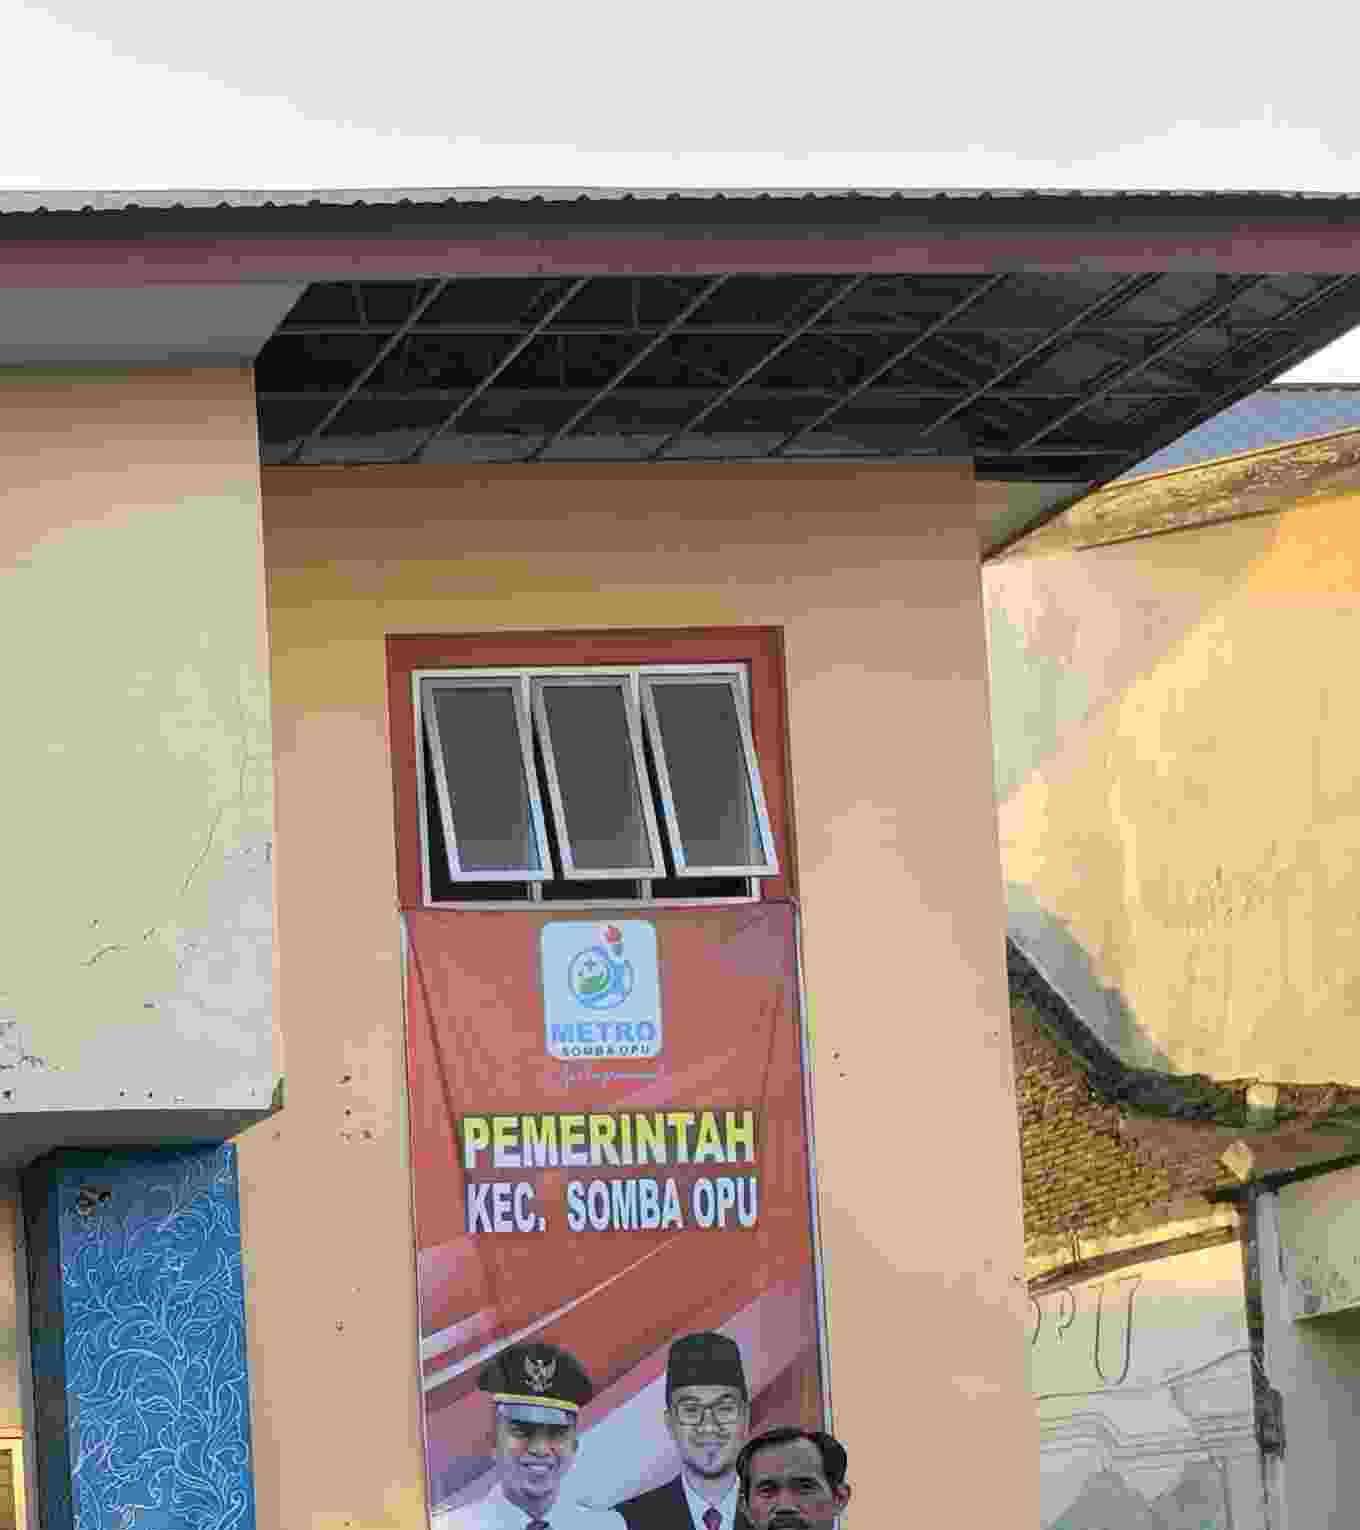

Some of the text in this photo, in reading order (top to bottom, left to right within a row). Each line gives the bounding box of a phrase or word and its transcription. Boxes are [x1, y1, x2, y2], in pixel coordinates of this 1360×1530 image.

[550, 1022, 657, 1043] METRO
[463, 1111, 754, 1168] PEMERINTAH
[467, 1177, 758, 1232] KEC. SOMBA OPU
